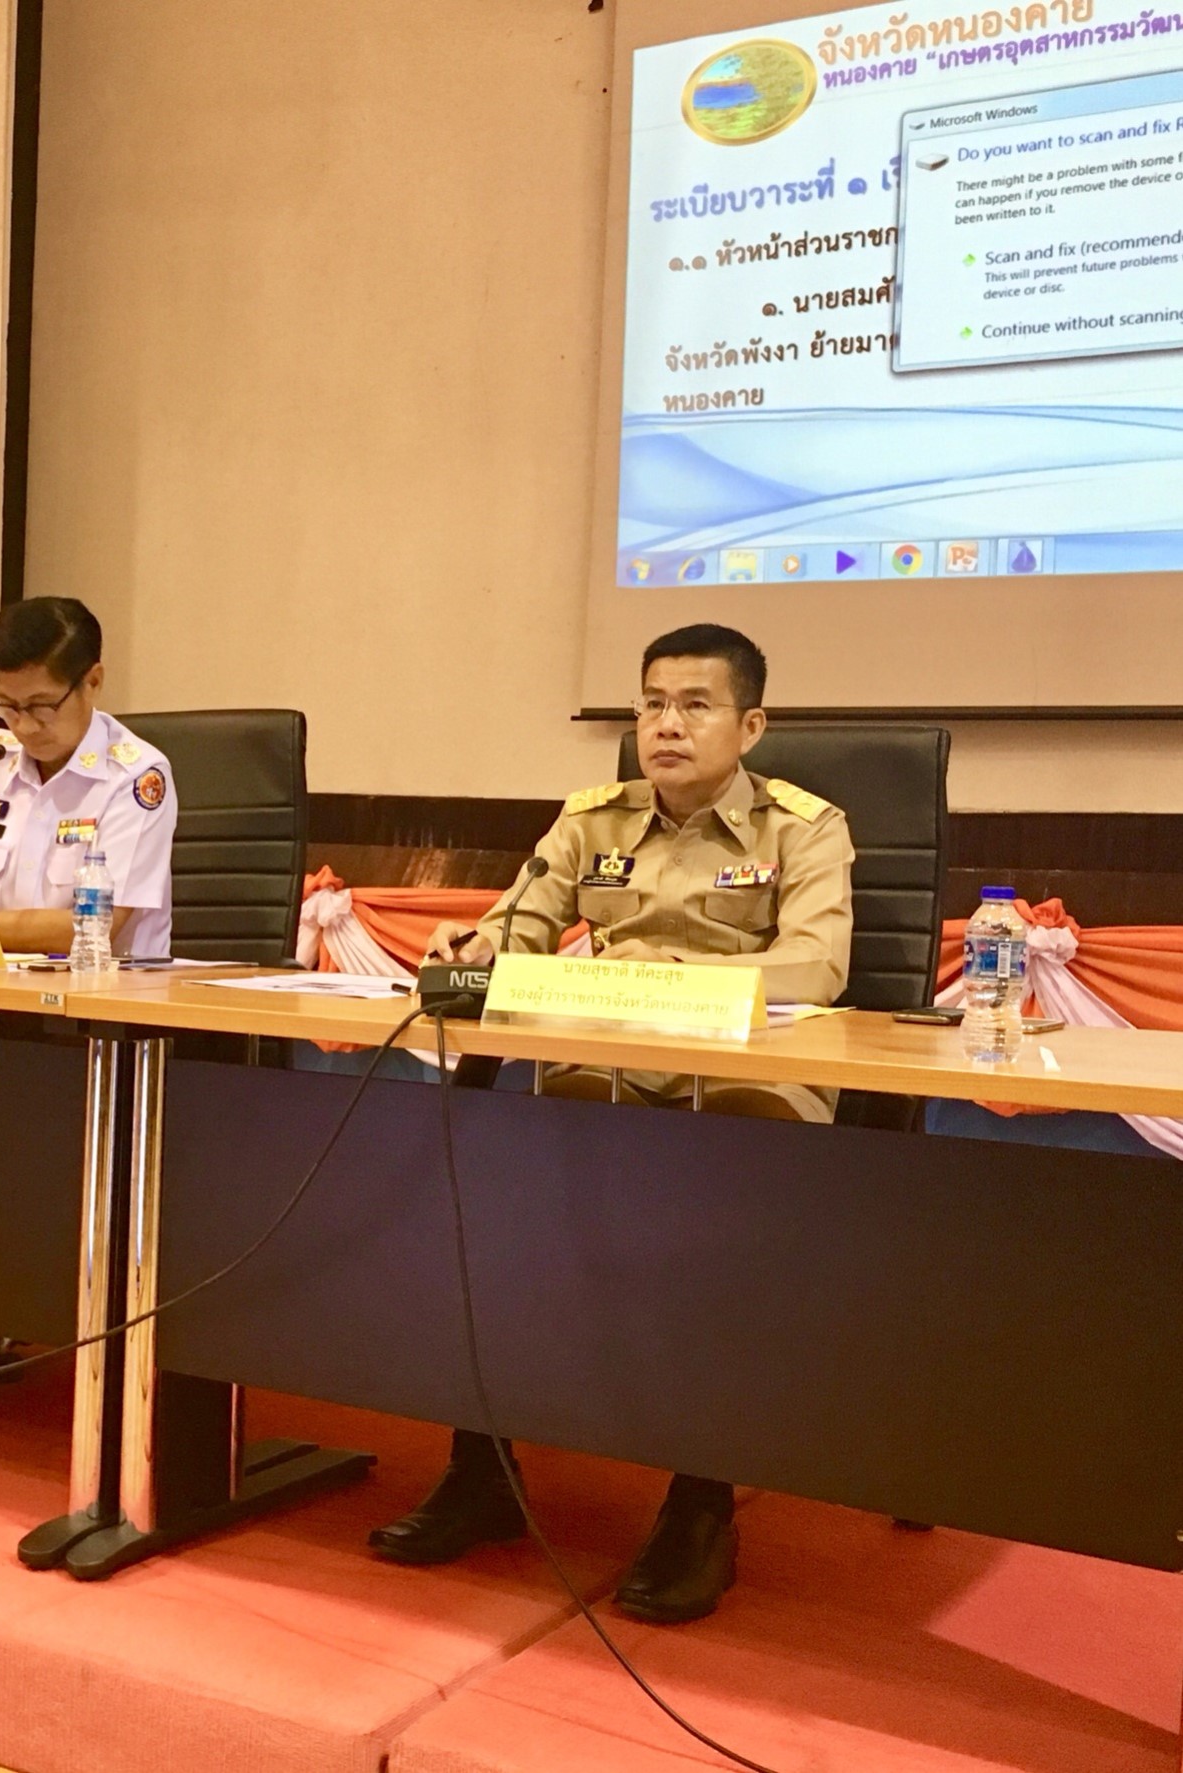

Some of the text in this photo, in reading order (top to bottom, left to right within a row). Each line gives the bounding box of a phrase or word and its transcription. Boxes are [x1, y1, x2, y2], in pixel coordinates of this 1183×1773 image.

[818, 0, 1094, 65] จังหวัดหนองคาย
[823, 57, 917, 89] หนองคาย
[930, 104, 1039, 129] Microsoft Windows
[958, 147, 979, 162] Do
[984, 145, 1012, 162] you
[1016, 137, 1053, 153] want
[1058, 135, 1075, 148] to
[1079, 131, 1113, 145] scan
[1118, 122, 1148, 139] and
[1153, 119, 1171, 134] fix
[649, 157, 836, 222] ระเบียบวาระที่
[847, 177, 868, 195] ๑
[956, 180, 988, 193] There
[991, 174, 1025, 189] might
[1028, 170, 1044, 183] be
[1046, 172, 1054, 181] a
[1057, 163, 1109, 181] problem
[1111, 159, 1138, 172] with
[1140, 155, 1175, 168] some
[955, 197, 976, 208] can
[978, 191, 1022, 212] happen
[1024, 188, 1034, 200] if
[1035, 188, 1058, 201] you
[1060, 182, 1106, 196] remove
[1109, 176, 1129, 189] the
[1131, 172, 1172, 187] device
[954, 203, 1056, 226] been written to it.
[668, 256, 708, 271] ๑.๑
[985, 231, 1183, 266] Scan and fix (recommend
[984, 252, 1178, 284] This will prevent future problems
[983, 282, 1066, 301] device or disc.
[762, 302, 784, 316] ๑.
[981, 321, 1050, 339] Continue
[1055, 314, 1115, 332] without
[665, 337, 799, 373] จังหวัดพังงา
[663, 387, 765, 413] หนองคาย
[450, 970, 490, 989] NTS
